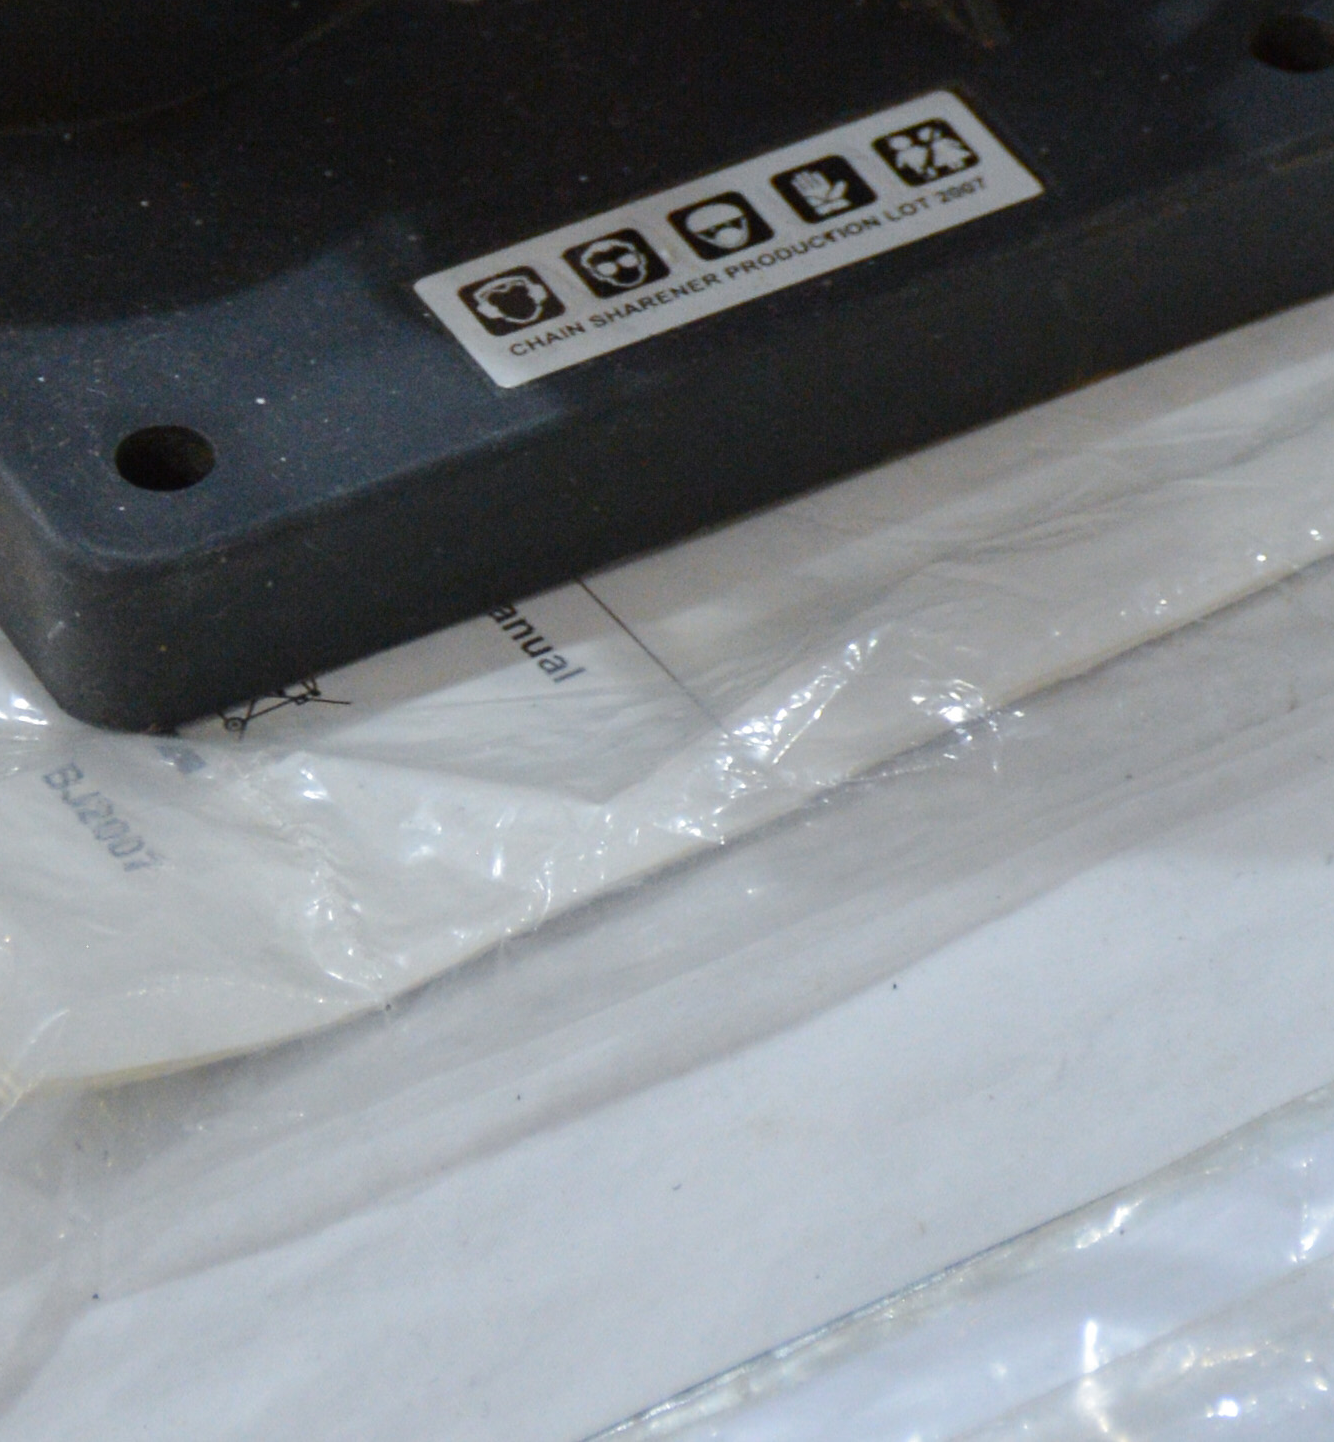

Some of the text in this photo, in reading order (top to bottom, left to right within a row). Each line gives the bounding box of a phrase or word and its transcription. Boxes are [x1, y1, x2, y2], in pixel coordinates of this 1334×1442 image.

[509, 321, 586, 357] CHAIN
[588, 271, 722, 329] SHARENER
[723, 216, 882, 280] PRODUCTION
[882, 197, 930, 222] LOT
[489, 602, 587, 684] anual
